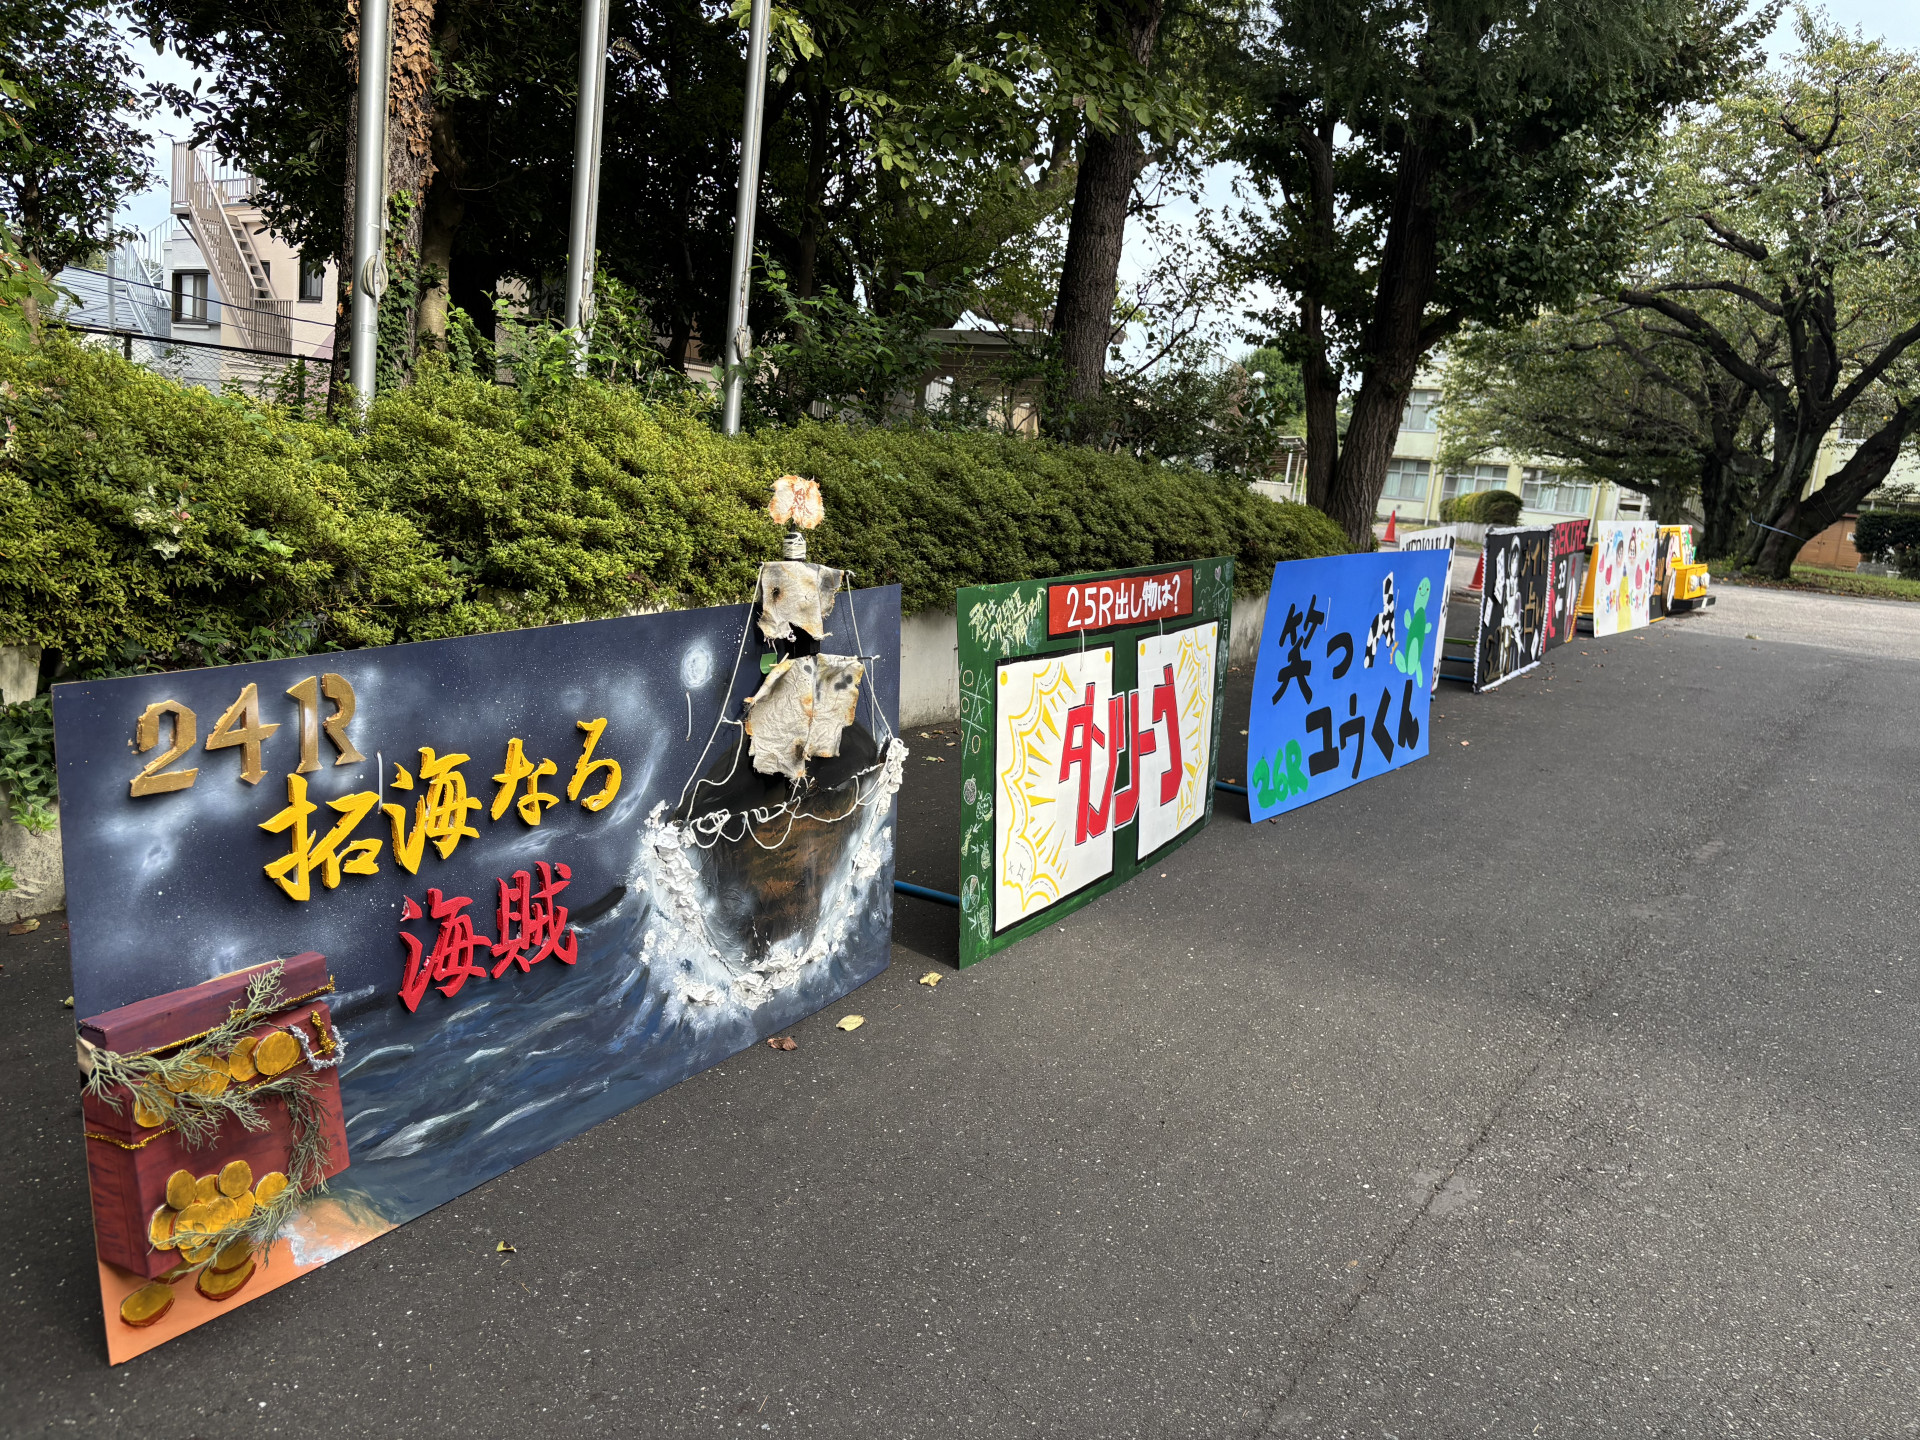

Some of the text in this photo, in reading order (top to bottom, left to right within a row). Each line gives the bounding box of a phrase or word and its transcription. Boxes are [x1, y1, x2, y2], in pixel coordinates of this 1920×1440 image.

[129, 673, 367, 797] 24R
[1253, 739, 1309, 808] 26R
[1306, 679, 1420, 779] コウくん
[258, 717, 623, 901] 拓海なる
[398, 861, 578, 1013] 海賊
